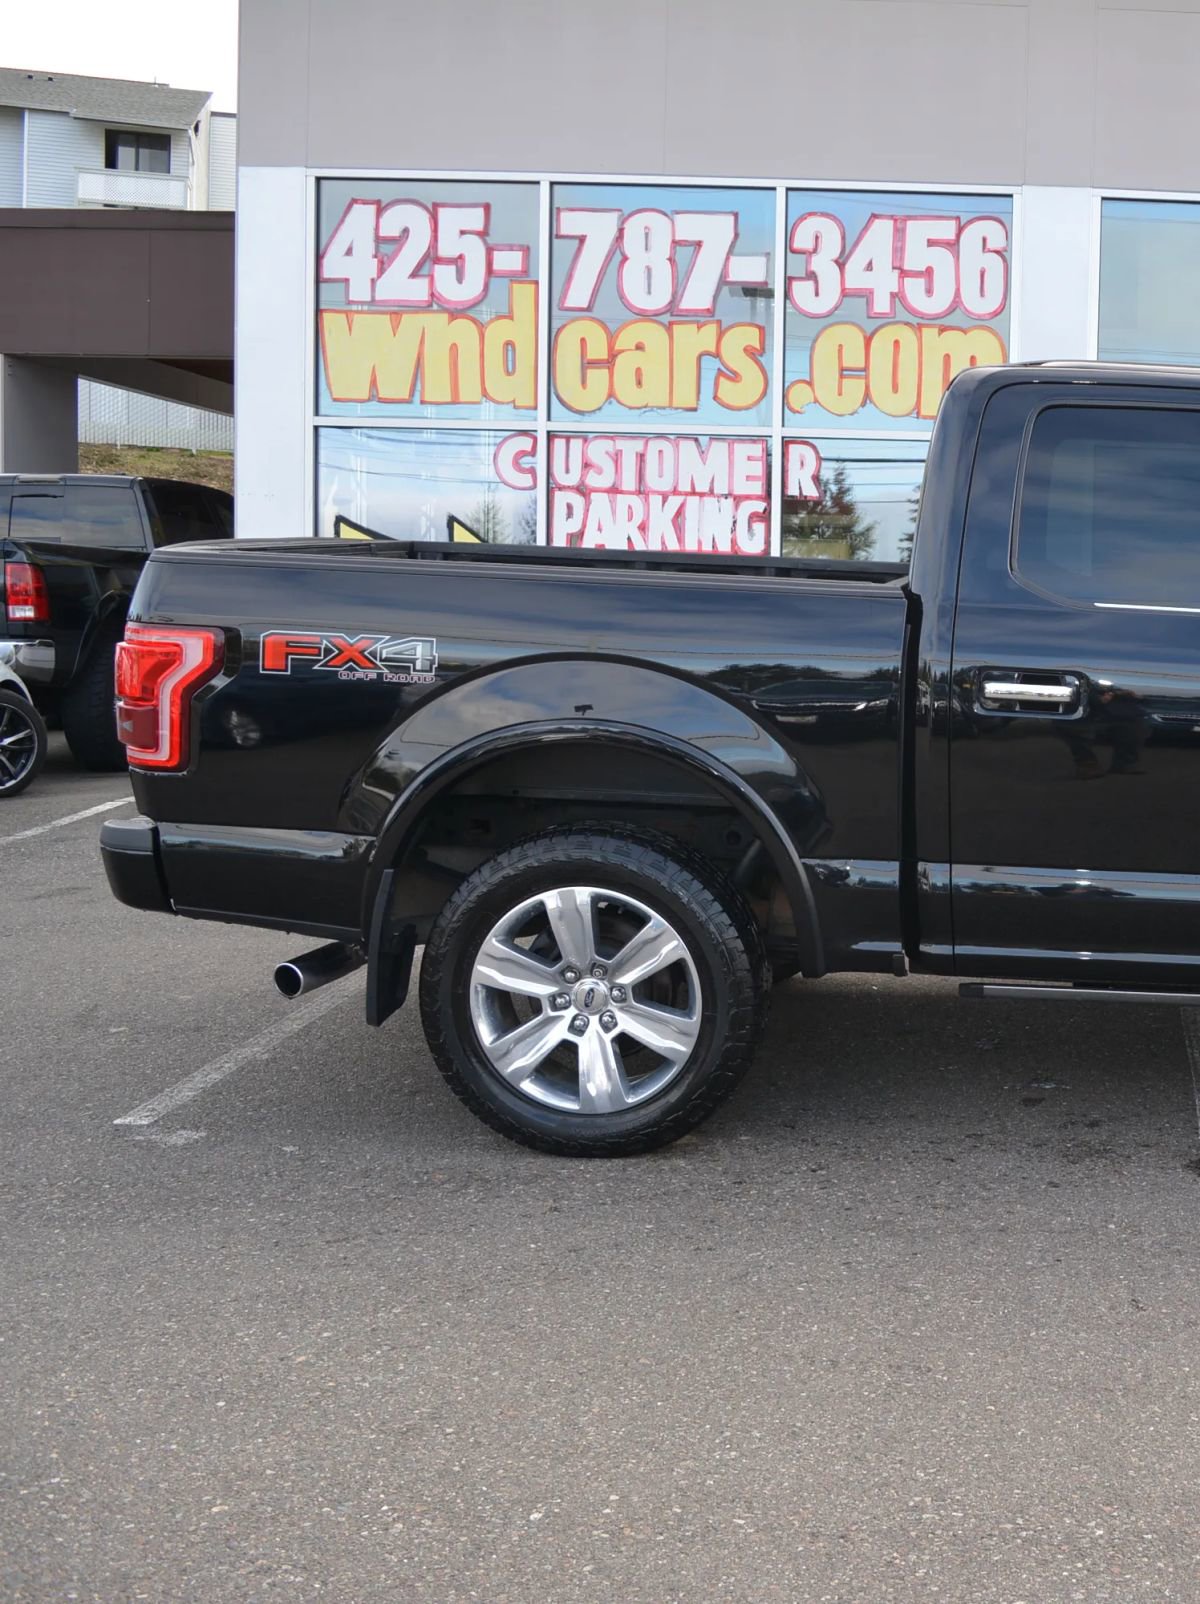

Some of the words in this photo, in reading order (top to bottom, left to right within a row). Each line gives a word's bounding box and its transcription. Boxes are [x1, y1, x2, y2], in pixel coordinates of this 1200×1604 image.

[550, 488, 770, 556] PARKING
[260, 630, 439, 676] FX4
[338, 671, 377, 681] OFF
[383, 672, 436, 683] ROAD
